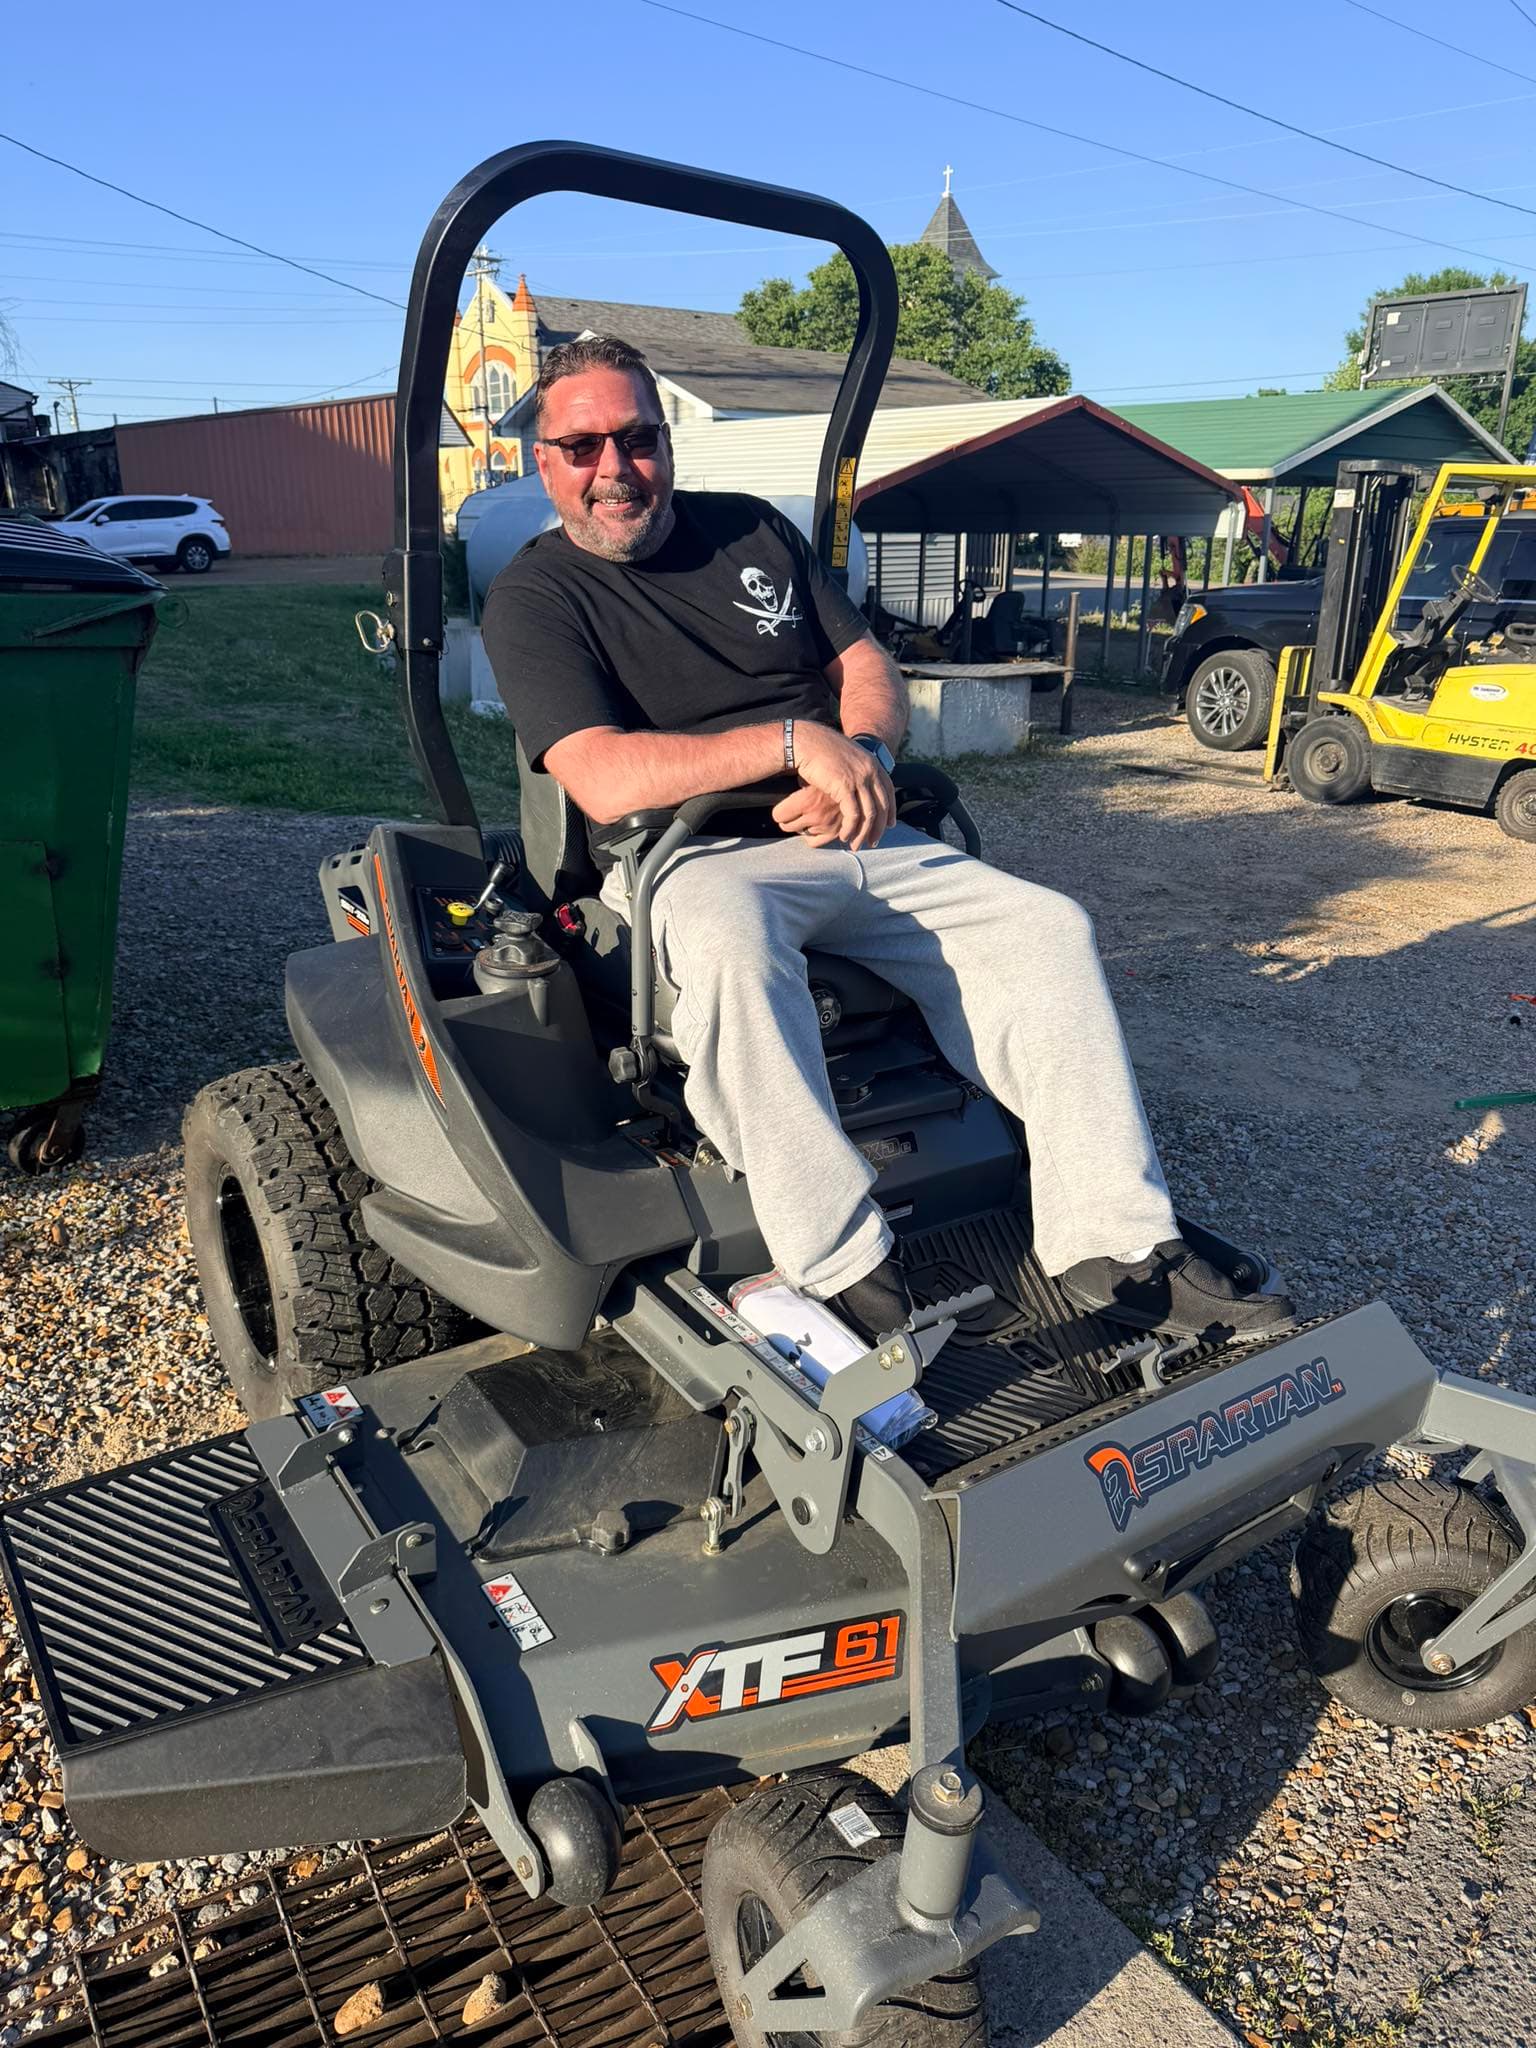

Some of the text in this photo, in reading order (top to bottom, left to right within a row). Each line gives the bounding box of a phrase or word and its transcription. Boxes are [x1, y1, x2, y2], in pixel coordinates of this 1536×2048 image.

[1448, 733, 1510, 751] HYSTER
[1132, 1362, 1331, 1492] SPARTAN
[231, 1511, 323, 1638] SPARTAN
[648, 1615, 900, 1733] XTF 61
